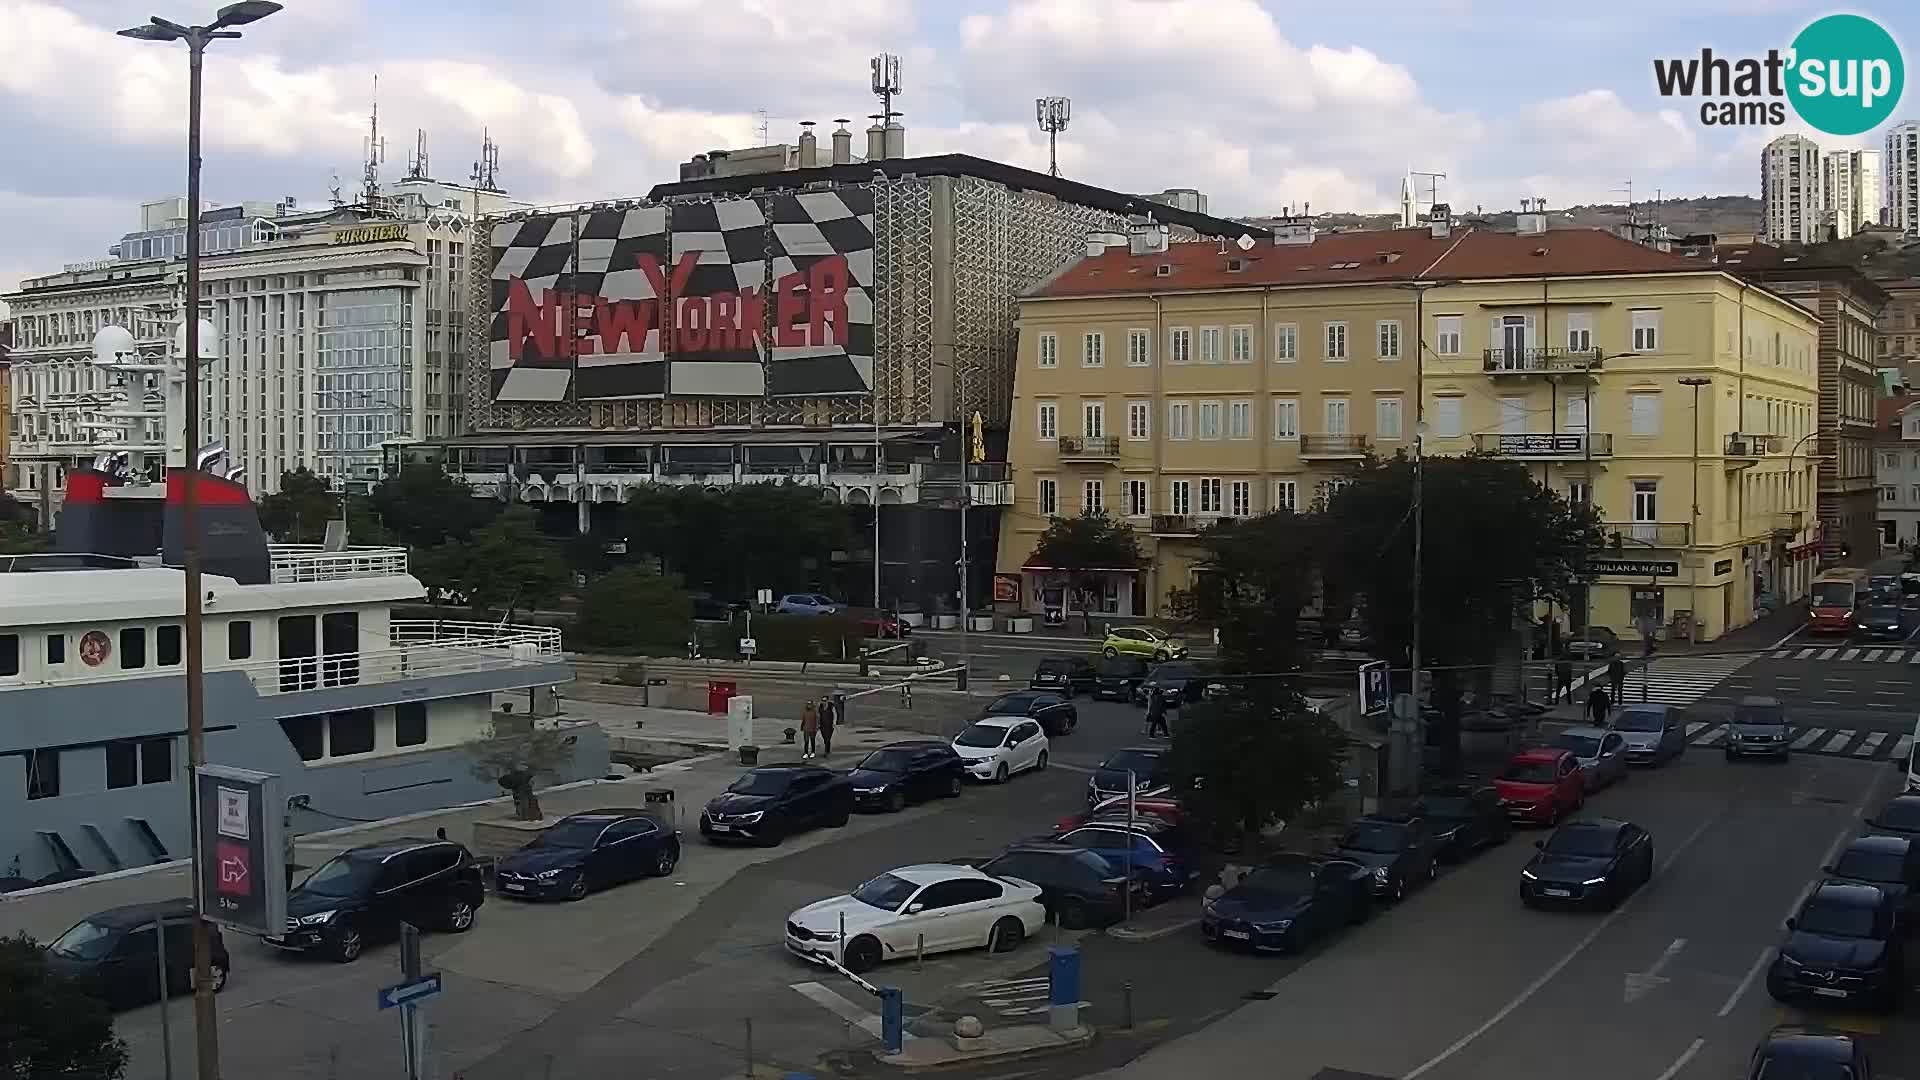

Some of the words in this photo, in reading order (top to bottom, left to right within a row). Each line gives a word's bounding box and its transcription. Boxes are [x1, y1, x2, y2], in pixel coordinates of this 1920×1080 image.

[508, 274, 651, 361] NEW
[636, 250, 850, 354] YORKER
[1593, 563, 1638, 573] JULIANA
[1641, 564, 1673, 574] NAILS
